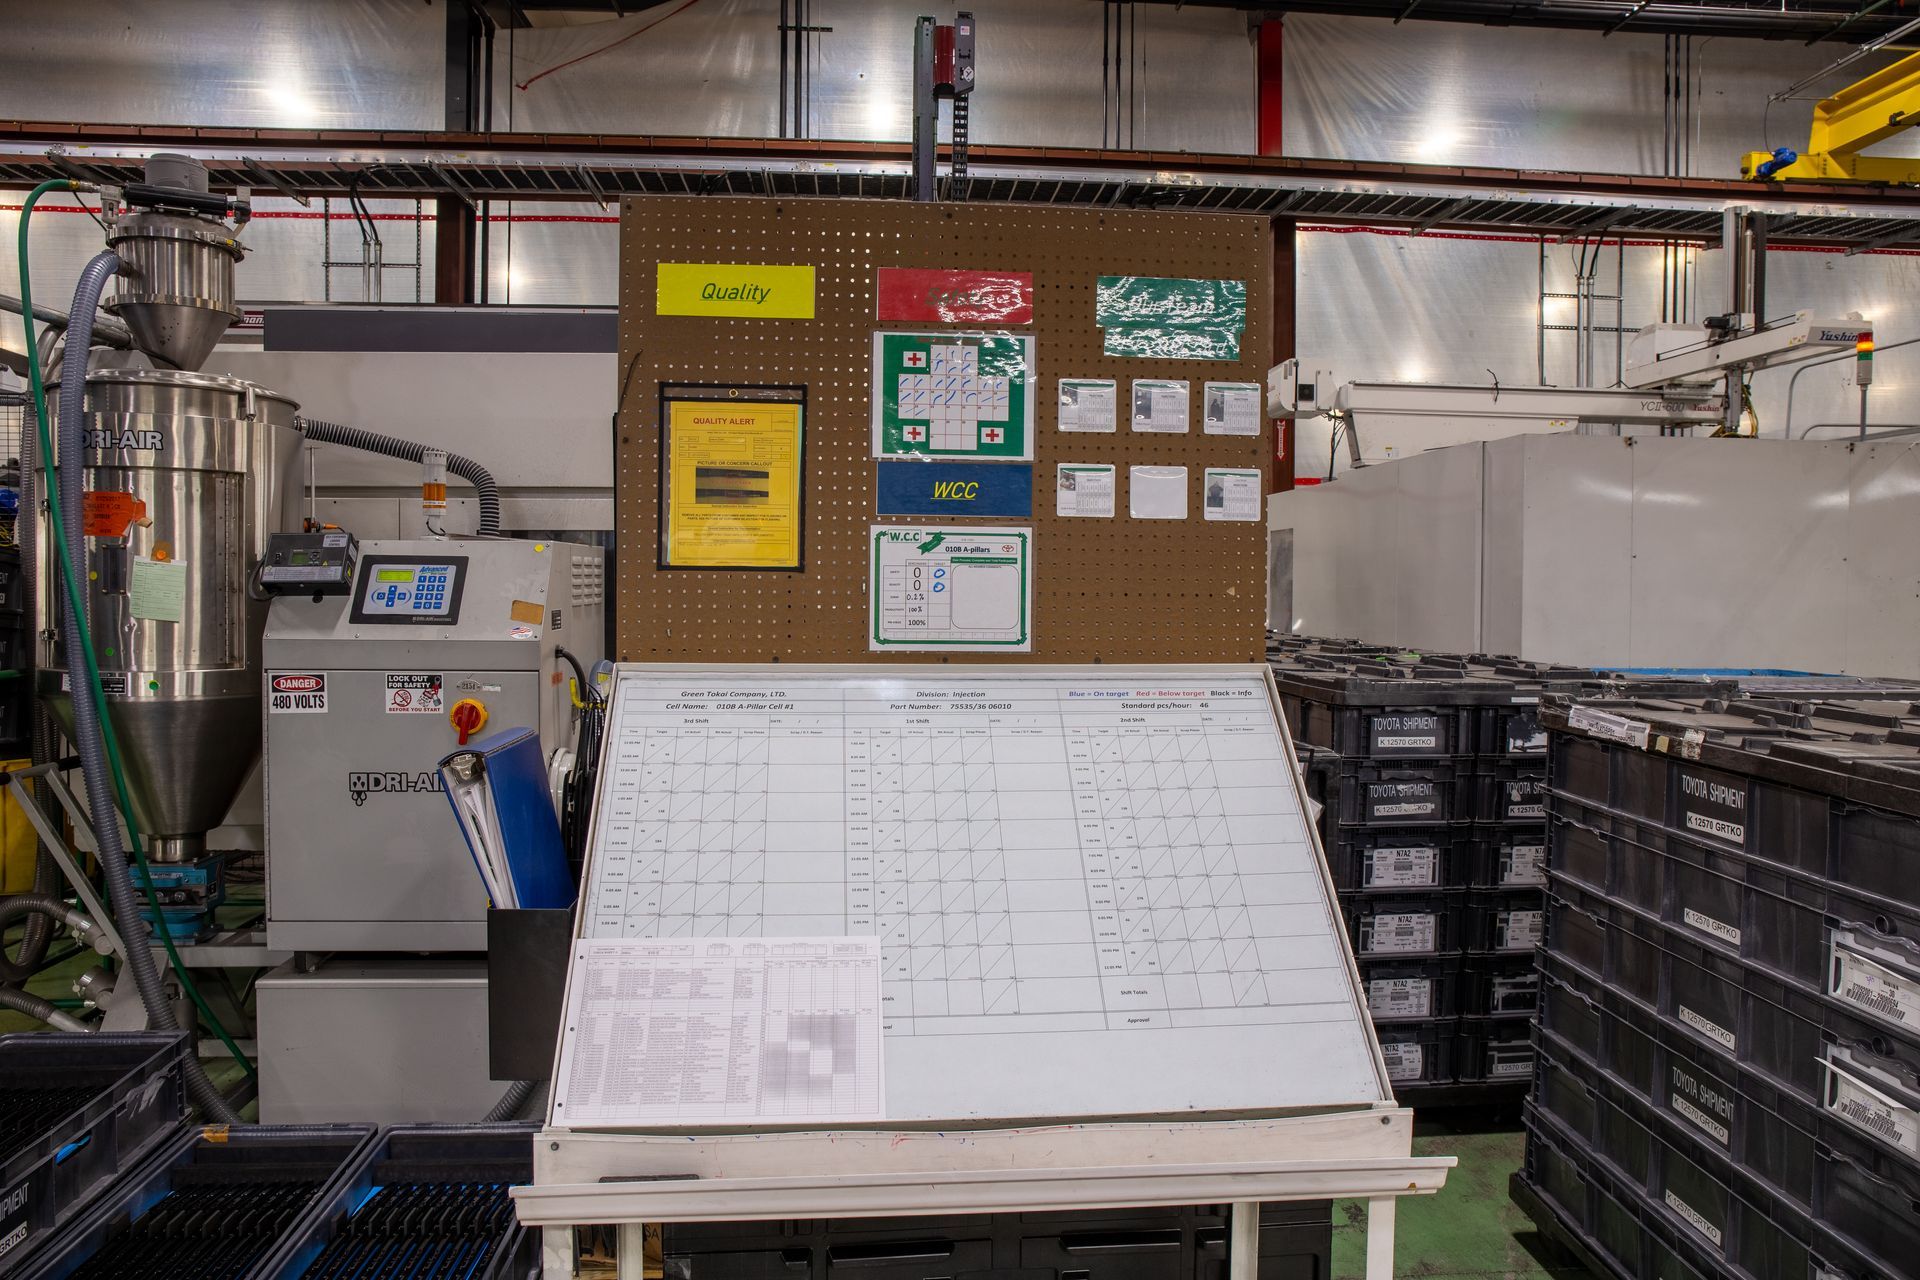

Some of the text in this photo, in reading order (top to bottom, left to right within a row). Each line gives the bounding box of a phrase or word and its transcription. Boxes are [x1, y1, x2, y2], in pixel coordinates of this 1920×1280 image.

[701, 282, 771, 304] Quality
[1818, 330, 1858, 342] Yushin
[1692, 404, 1720, 412] Yushin
[693, 417, 756, 426] QUALITY ALERT
[933, 481, 979, 500] WCC
[890, 532, 920, 542] W.C.C
[963, 546, 991, 554] A-pillars
[914, 567, 921, 578] 0
[914, 580, 921, 590] 0
[280, 679, 316, 689] DANGER
[272, 694, 324, 709] 480 VOLTS
[953, 691, 986, 699] Injection
[950, 703, 986, 711] 75535/36
[1157, 702, 1192, 710] pcs/hour:
[1374, 717, 1437, 730] TOYOTA SHIPMENT
[368, 772, 444, 792] DRI-AI
[1506, 782, 1531, 795] TOYOTA
[1370, 784, 1433, 797] TOYOTA SHIPMENT
[1682, 774, 1745, 809] TOYOTA SHIPMENT
[1688, 816, 1742, 836] K 12570 GRTKO
[1686, 910, 1737, 939] K 12570 GRTKO
[1680, 1008, 1731, 1043] K 12570 GRTKO
[1673, 1066, 1733, 1122] TOYOTA SHIPMENT
[1674, 1096, 1724, 1138] K 12570 GRTKO
[0, 1182, 29, 1220] IPMENT
[1667, 1192, 1717, 1238] K 12570 GRTKO
